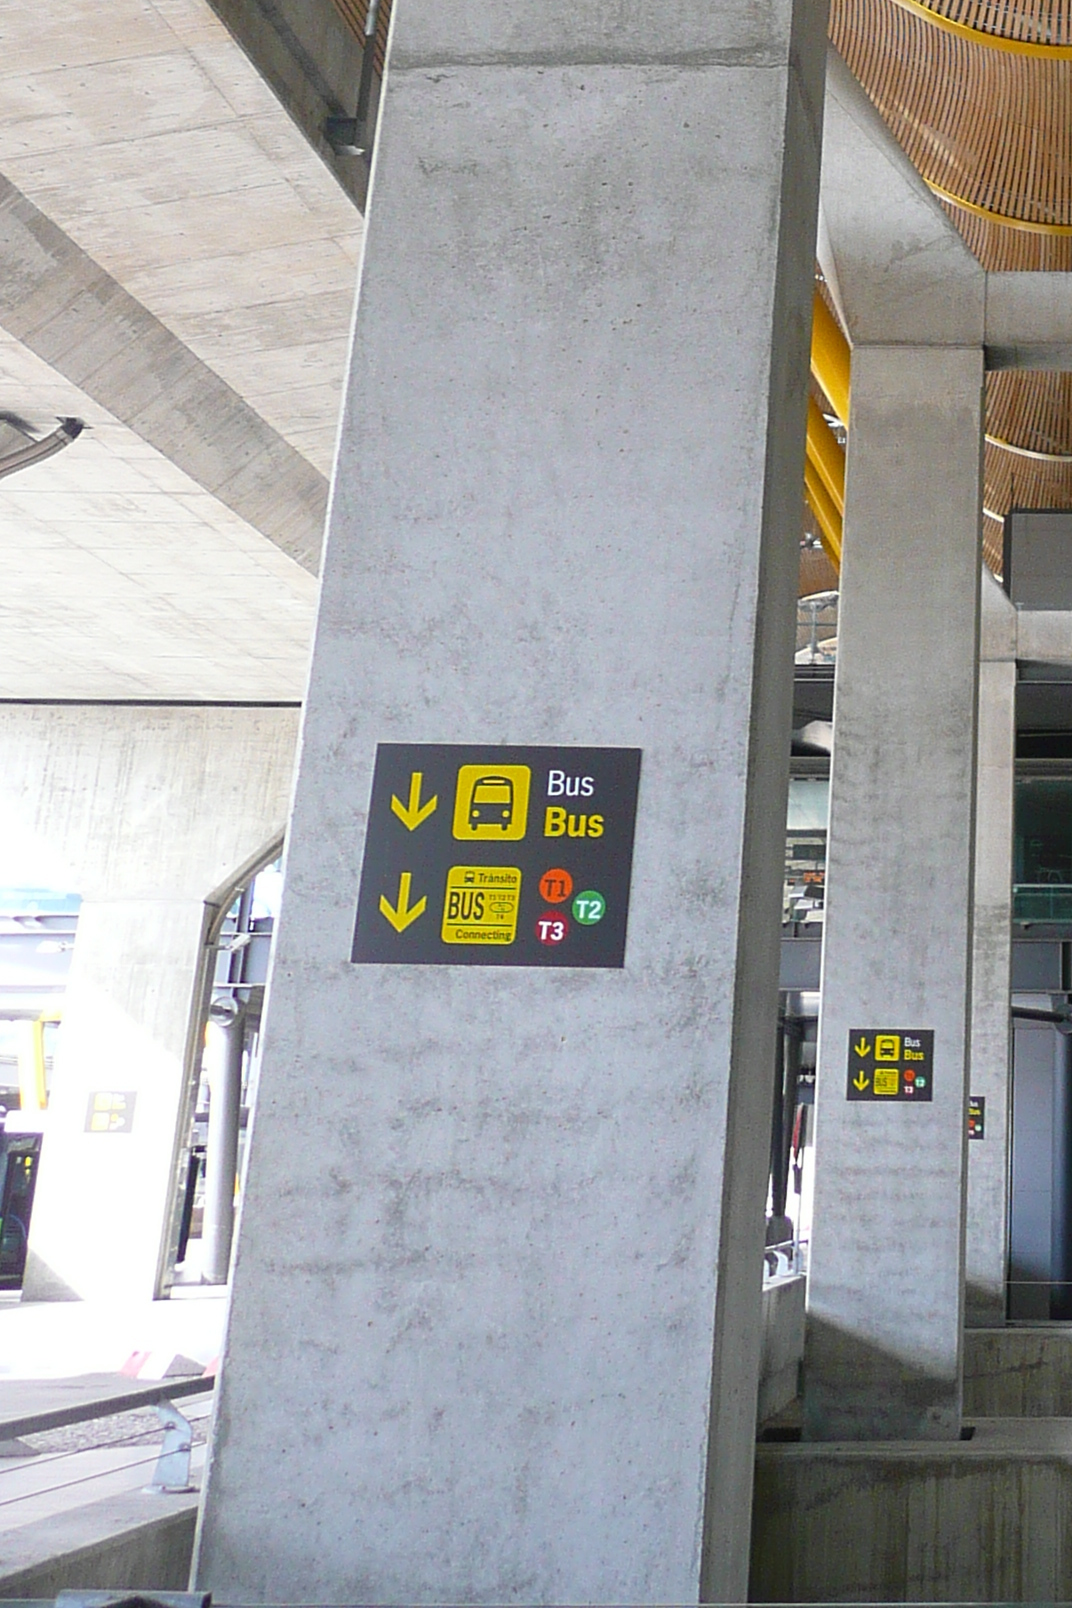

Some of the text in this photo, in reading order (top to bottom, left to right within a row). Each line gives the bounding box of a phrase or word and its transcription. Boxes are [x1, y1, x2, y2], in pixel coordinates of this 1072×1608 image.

[547, 770, 594, 796] Bus
[544, 807, 604, 837] Bus
[478, 872, 518, 884] Tránsito
[544, 878, 567, 898] T1
[447, 891, 485, 921] BUS
[576, 900, 602, 920] T2
[455, 928, 512, 942] Connecting
[537, 920, 565, 941] T3
[904, 1037, 921, 1047] Bus
[904, 1049, 924, 1060] Bus
